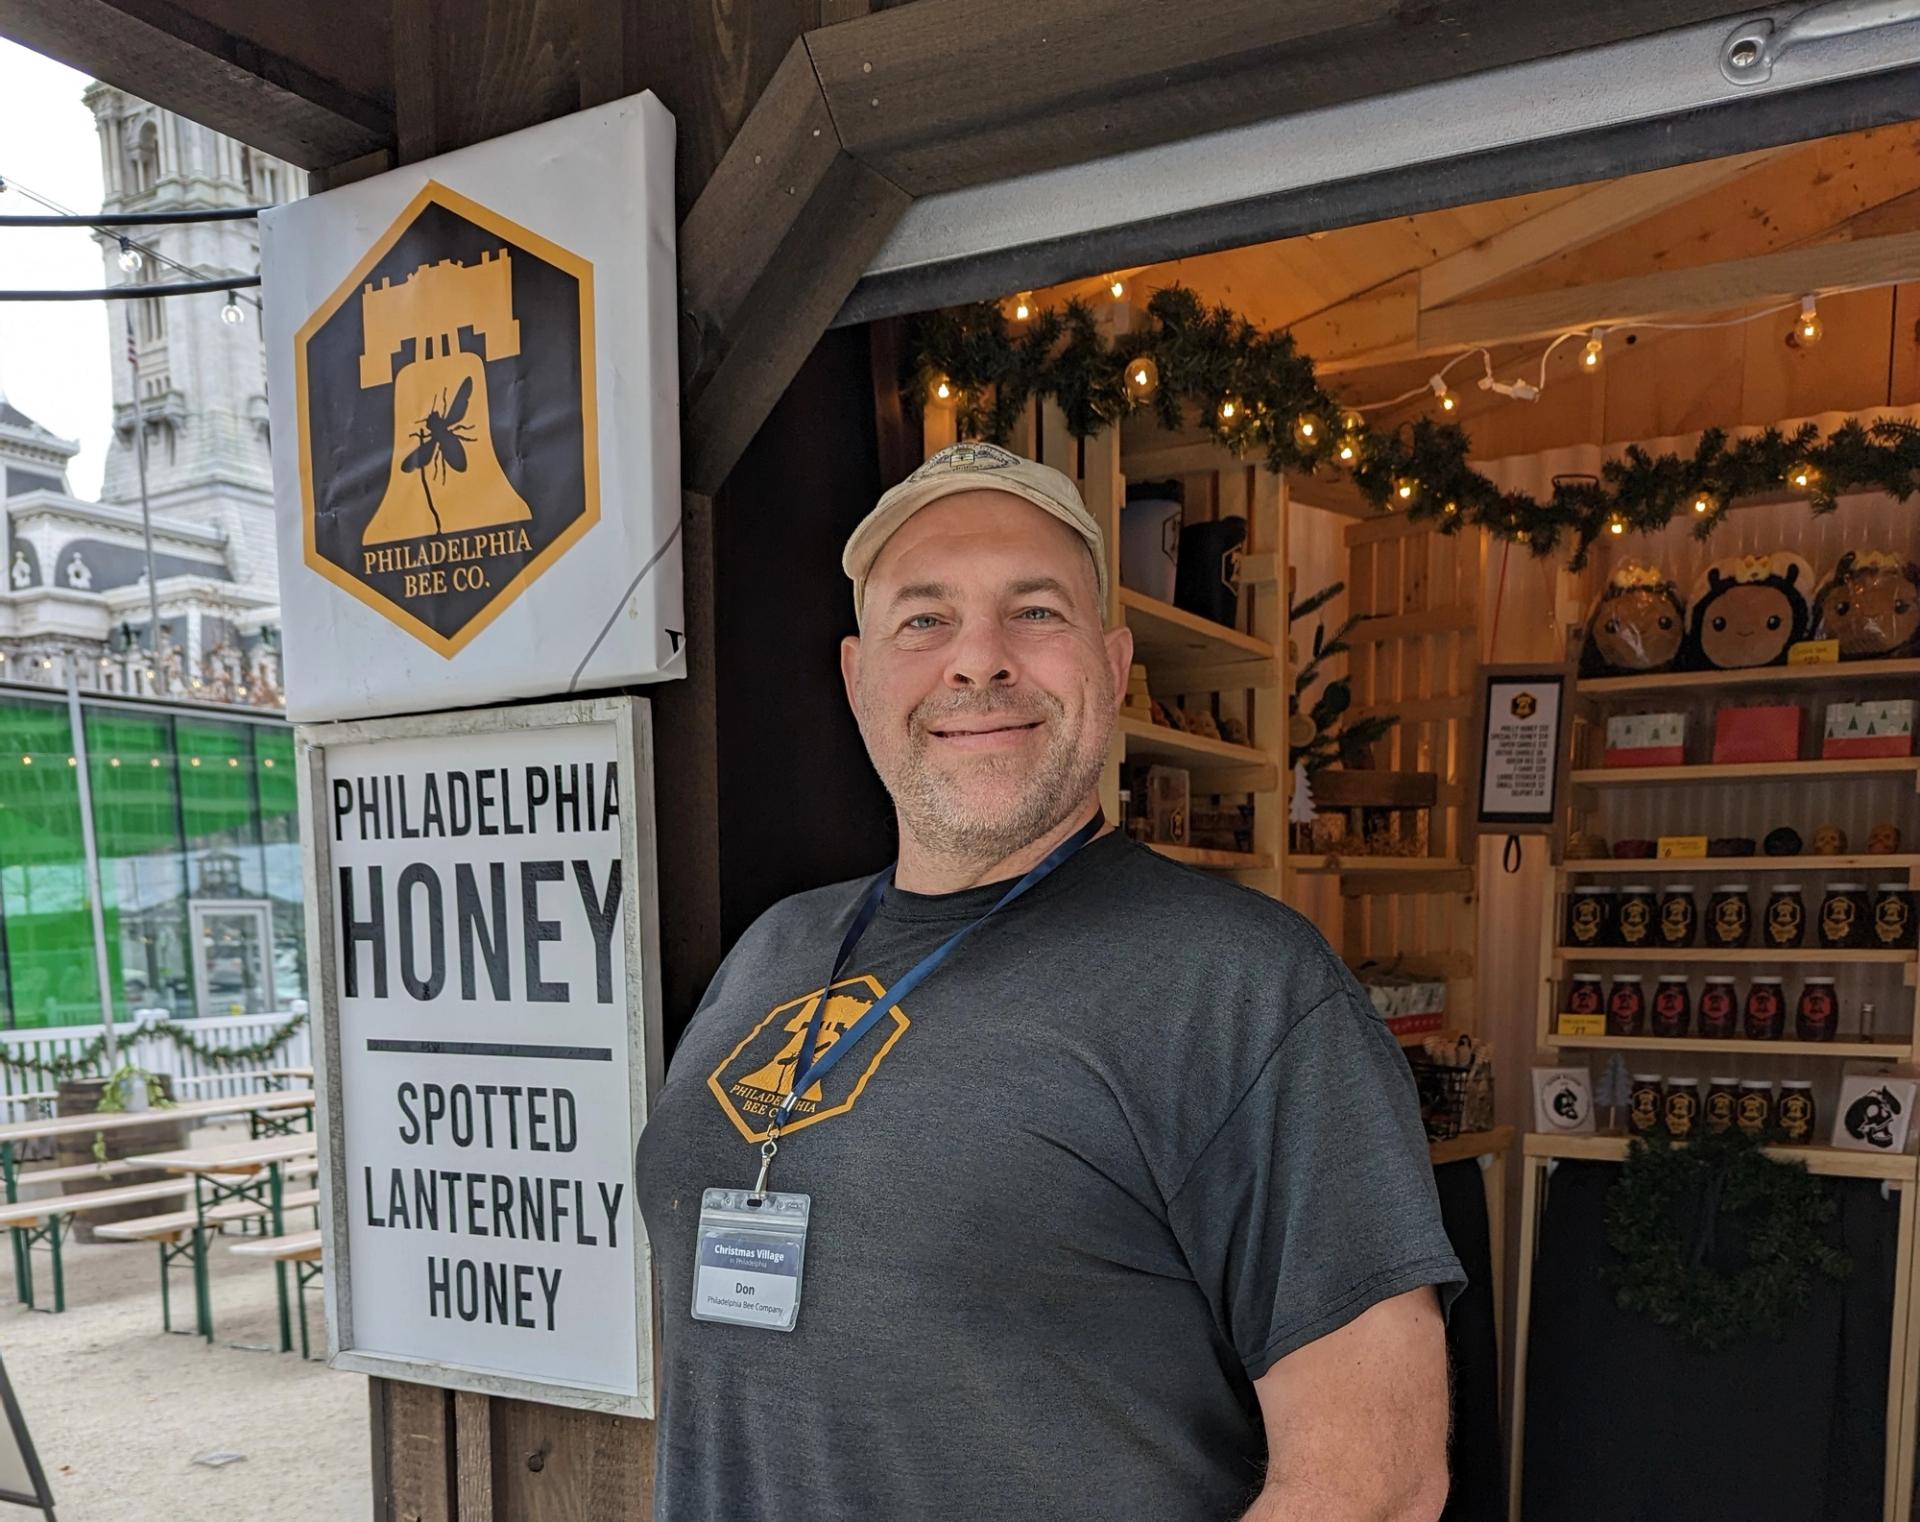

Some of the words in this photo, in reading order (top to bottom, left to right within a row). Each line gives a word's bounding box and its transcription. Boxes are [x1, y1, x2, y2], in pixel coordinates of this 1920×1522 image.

[363, 527, 533, 575] PHILADELPHIA
[404, 570, 448, 598] BEE
[453, 565, 491, 592] CO.
[333, 760, 621, 842] PHILADELPHIA
[339, 859, 624, 1004] HONEY
[398, 1081, 578, 1153] SPOTTED
[729, 1084, 817, 1113] PHILADEHIA
[742, 1099, 768, 1115] BEE
[364, 1165, 624, 1248] LANTERNFLY
[714, 1244, 756, 1259] Christmas
[756, 1248, 785, 1264] Village
[427, 1256, 563, 1332] HONEY
[707, 1295, 742, 1309] Philadelphia
[743, 1301, 755, 1311] Bee
[755, 1302, 784, 1317] Company
[735, 1282, 756, 1296] Don
